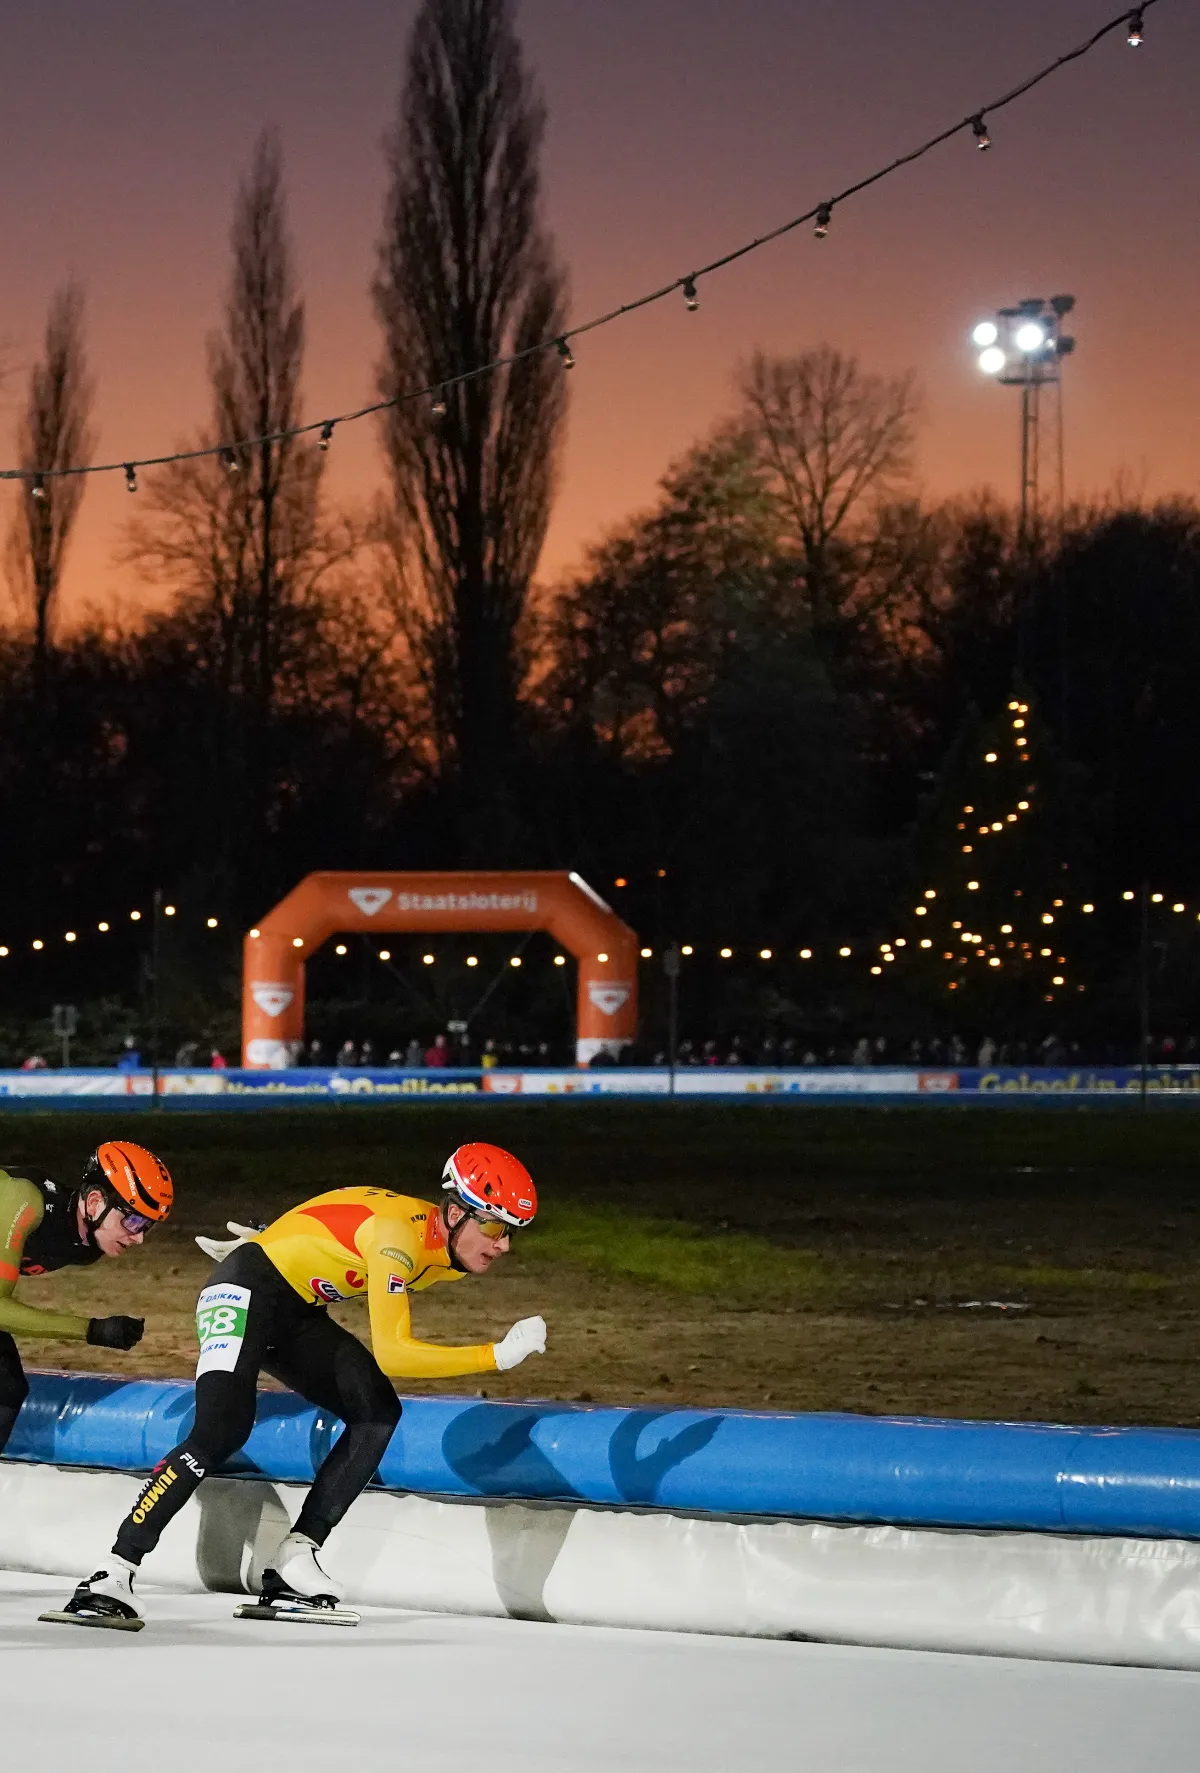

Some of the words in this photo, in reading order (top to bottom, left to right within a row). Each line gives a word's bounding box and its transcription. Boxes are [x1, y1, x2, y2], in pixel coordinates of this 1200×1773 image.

[397, 889, 538, 912] Staatsloterij
[205, 1292, 242, 1303] DAIKIN
[198, 1307, 238, 1344] 58
[179, 1452, 205, 1478] FILA
[132, 1465, 179, 1524] JUMBO
